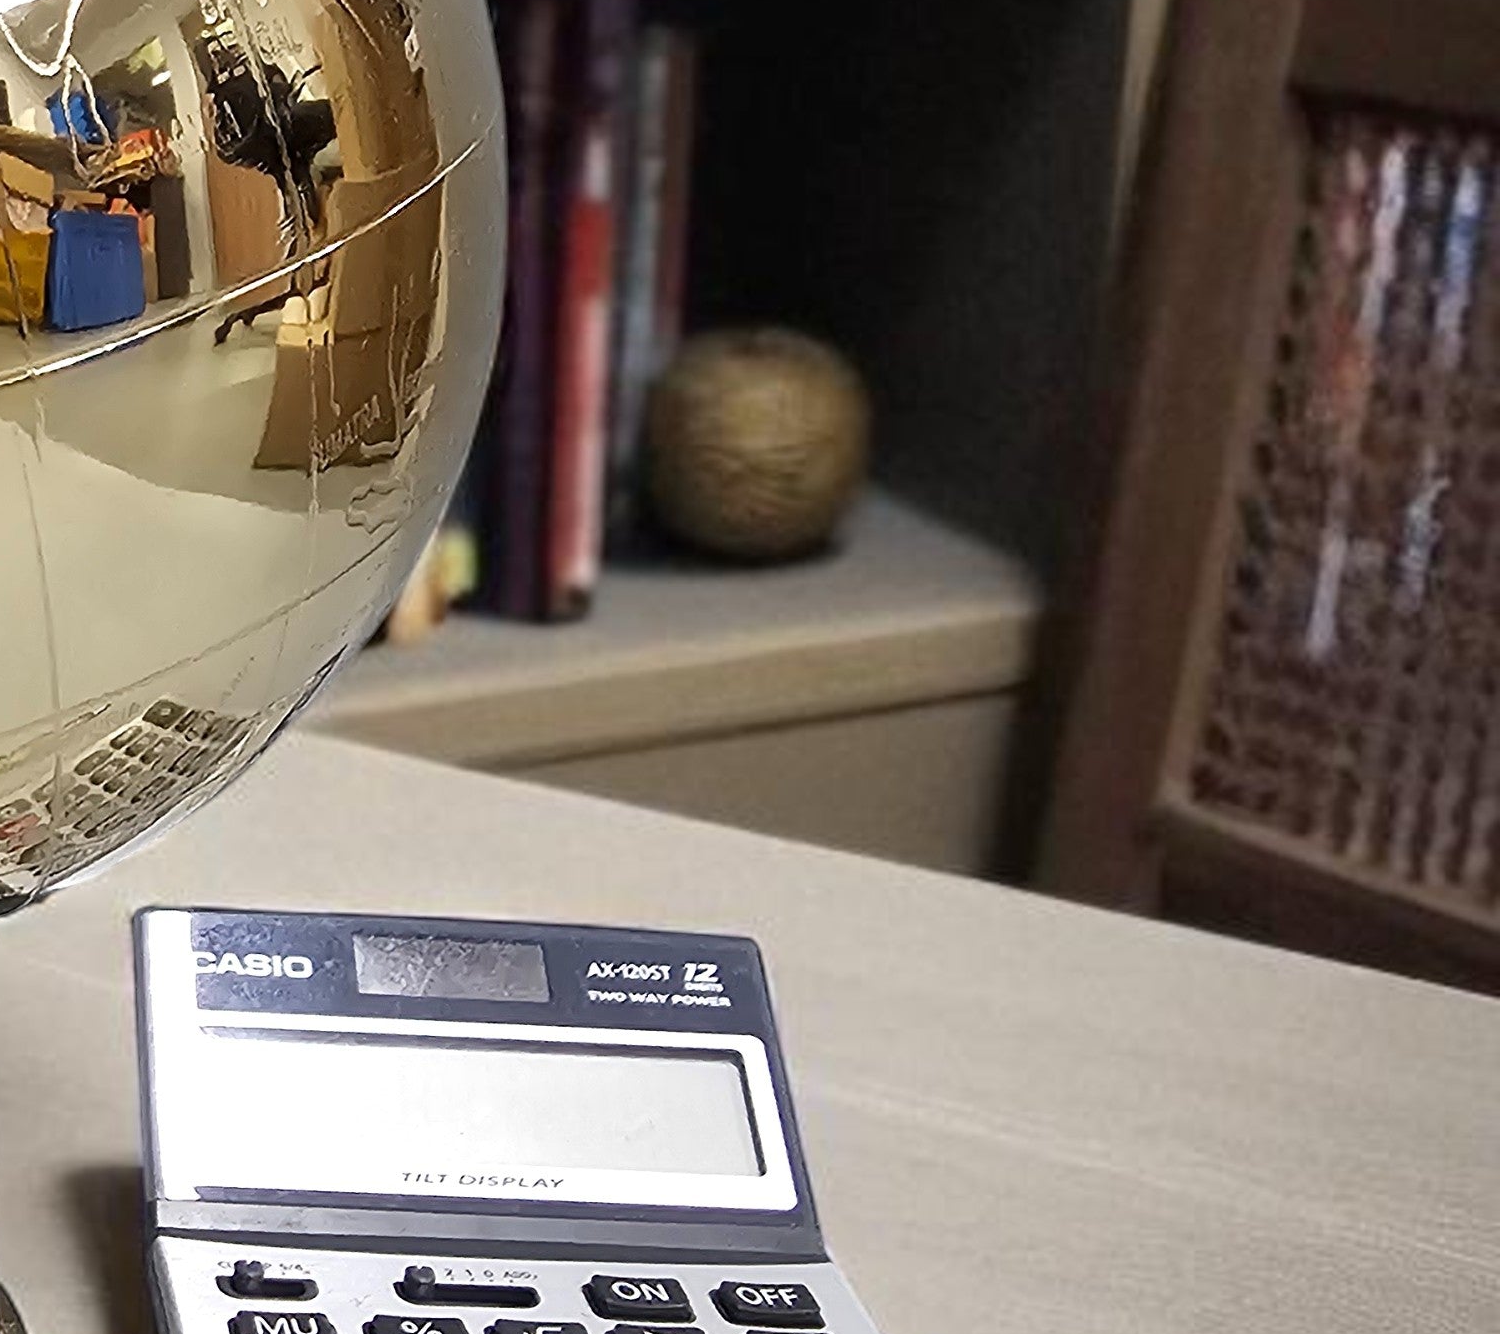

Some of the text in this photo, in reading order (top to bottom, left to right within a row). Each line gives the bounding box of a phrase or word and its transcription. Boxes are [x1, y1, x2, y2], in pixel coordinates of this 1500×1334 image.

[192, 950, 313, 980] CASIO
[683, 962, 719, 983] 12
[587, 988, 732, 1007] TWO WAY POWER
[401, 1169, 565, 1191] TILT DISPLAY
[610, 1280, 669, 1304] ON
[734, 1285, 798, 1310] OFF
